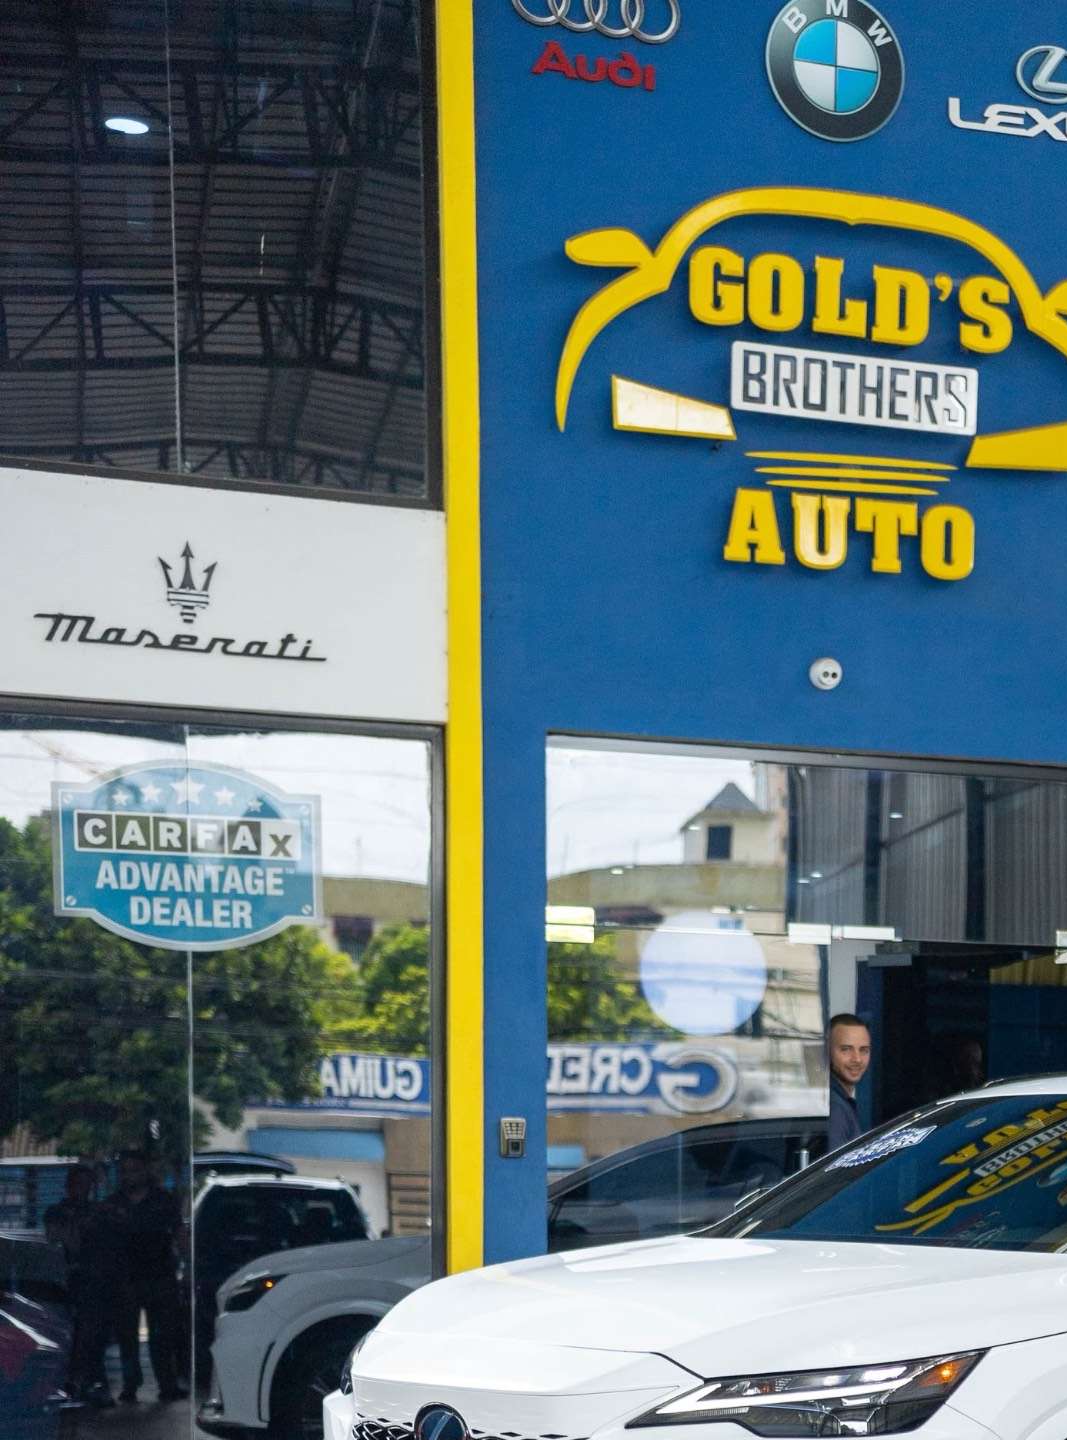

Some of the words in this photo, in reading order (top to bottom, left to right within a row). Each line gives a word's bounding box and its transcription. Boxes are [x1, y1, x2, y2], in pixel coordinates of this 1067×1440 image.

[782, 0, 893, 47] BMW
[532, 41, 656, 91] Audi
[688, 246, 1013, 354] GOLD'S
[742, 350, 969, 429] BROTHERS
[723, 488, 975, 581] AUTO
[34, 612, 326, 662] Maserati
[82, 815, 293, 858] CARFAX
[96, 860, 284, 896] ADVANTAGE
[130, 896, 252, 929] DEALER
